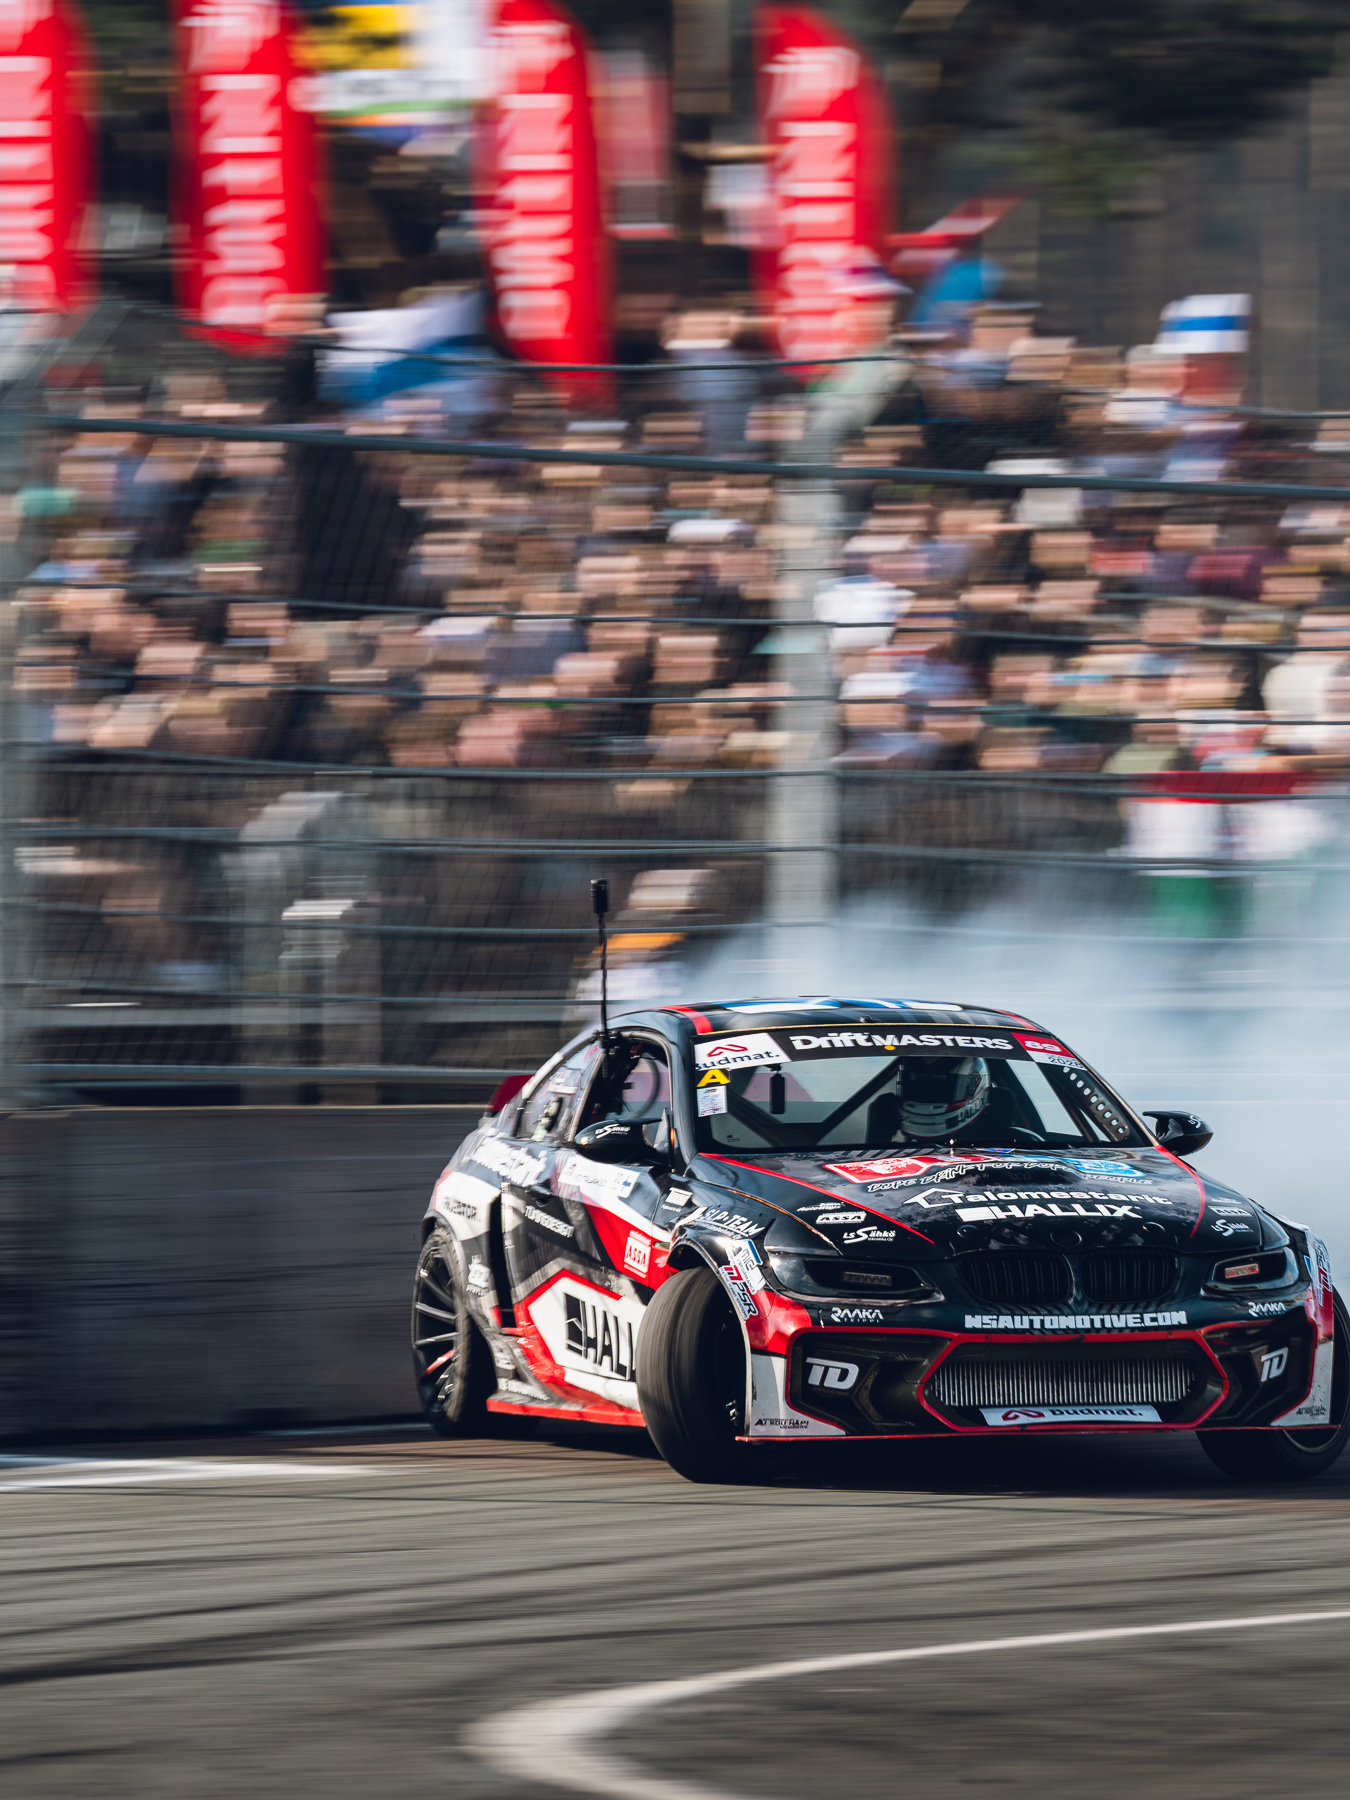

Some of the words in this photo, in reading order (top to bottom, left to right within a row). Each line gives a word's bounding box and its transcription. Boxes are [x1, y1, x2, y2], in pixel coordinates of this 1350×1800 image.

[1024, 1040, 1063, 1052] 89
[696, 1069, 731, 1088] A
[941, 1191, 1173, 1205] Talomestarit
[989, 1203, 1143, 1219] HALLIX
[625, 1245, 647, 1268] ASSA
[831, 1307, 884, 1322] RAAKA
[1248, 1301, 1287, 1317] RAAKA
